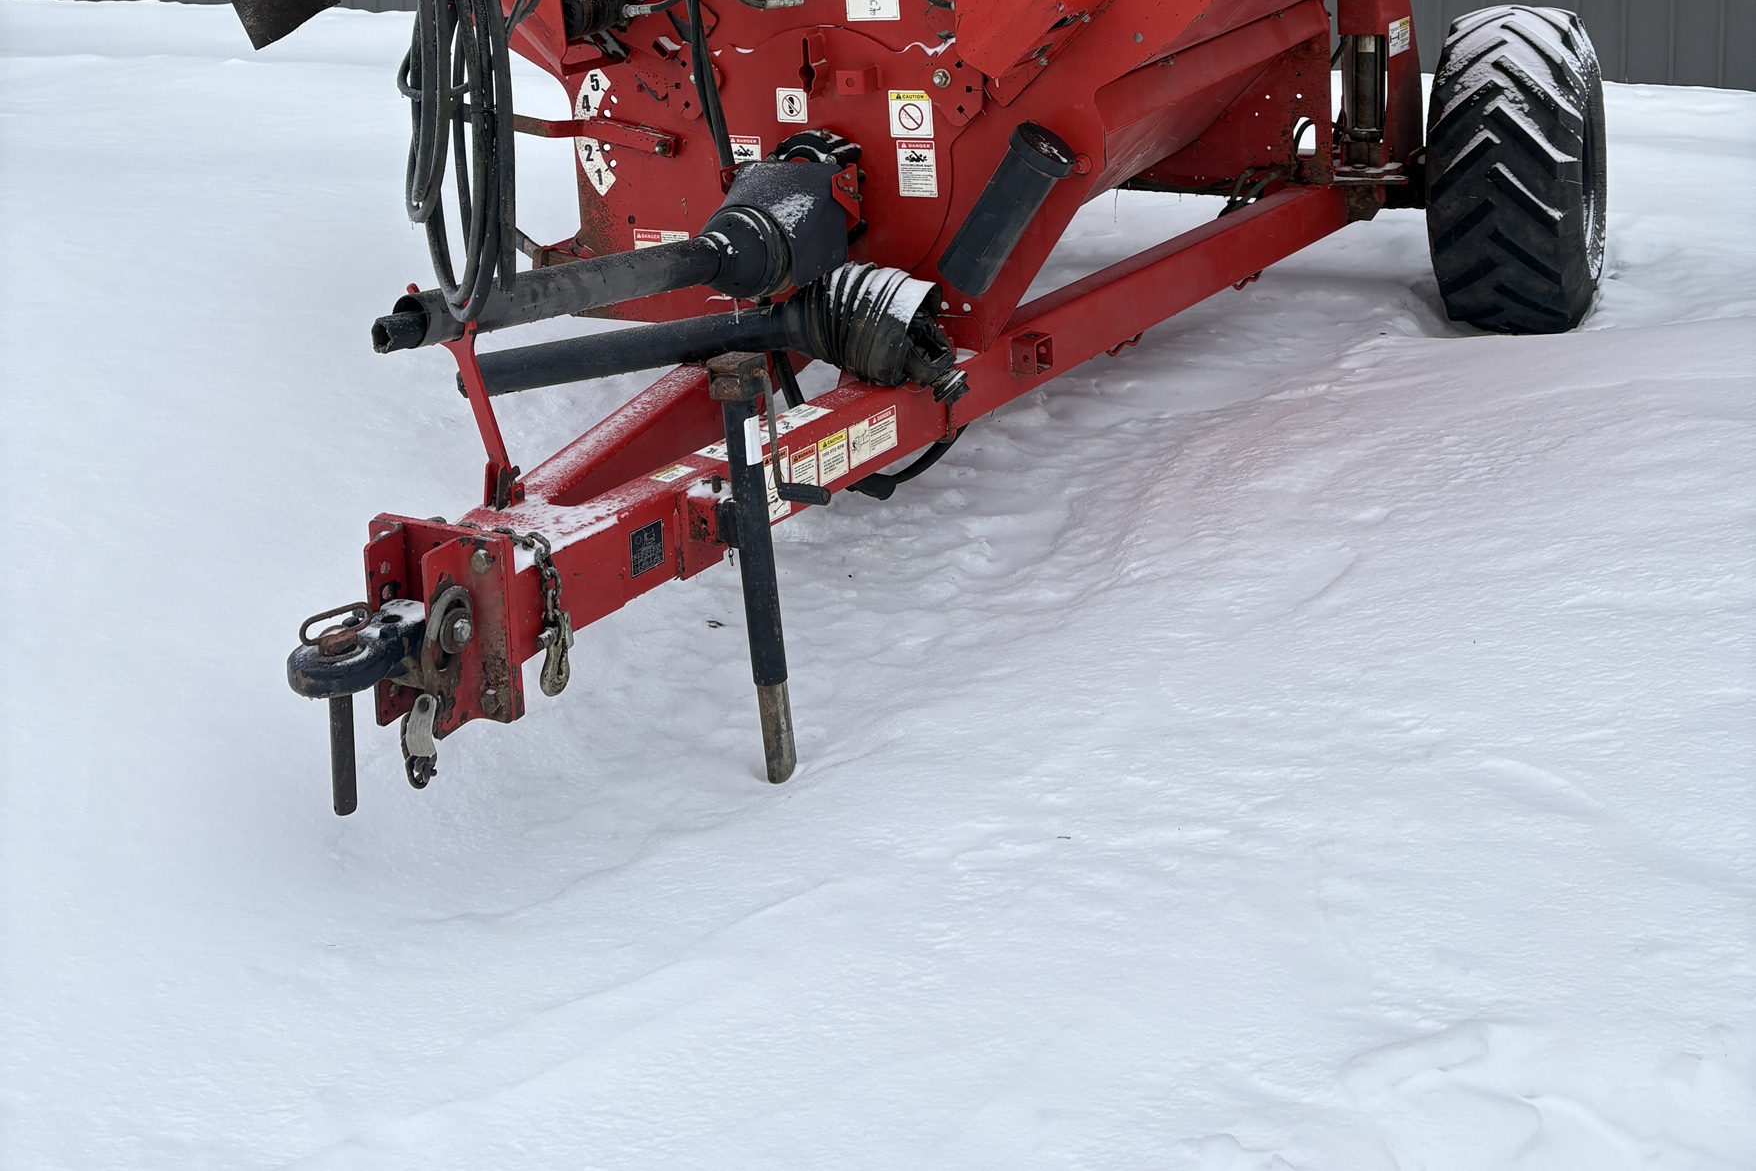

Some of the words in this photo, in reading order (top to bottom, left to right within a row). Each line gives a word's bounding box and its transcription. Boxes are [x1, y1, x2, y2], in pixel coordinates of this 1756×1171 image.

[589, 73, 600, 92] 5
[581, 94, 591, 112] 4
[584, 144, 594, 162] 2
[595, 168, 603, 185] 1
[877, 410, 892, 421] DANGER
[827, 434, 844, 446] CAUTION
[797, 448, 814, 459] WARNING
